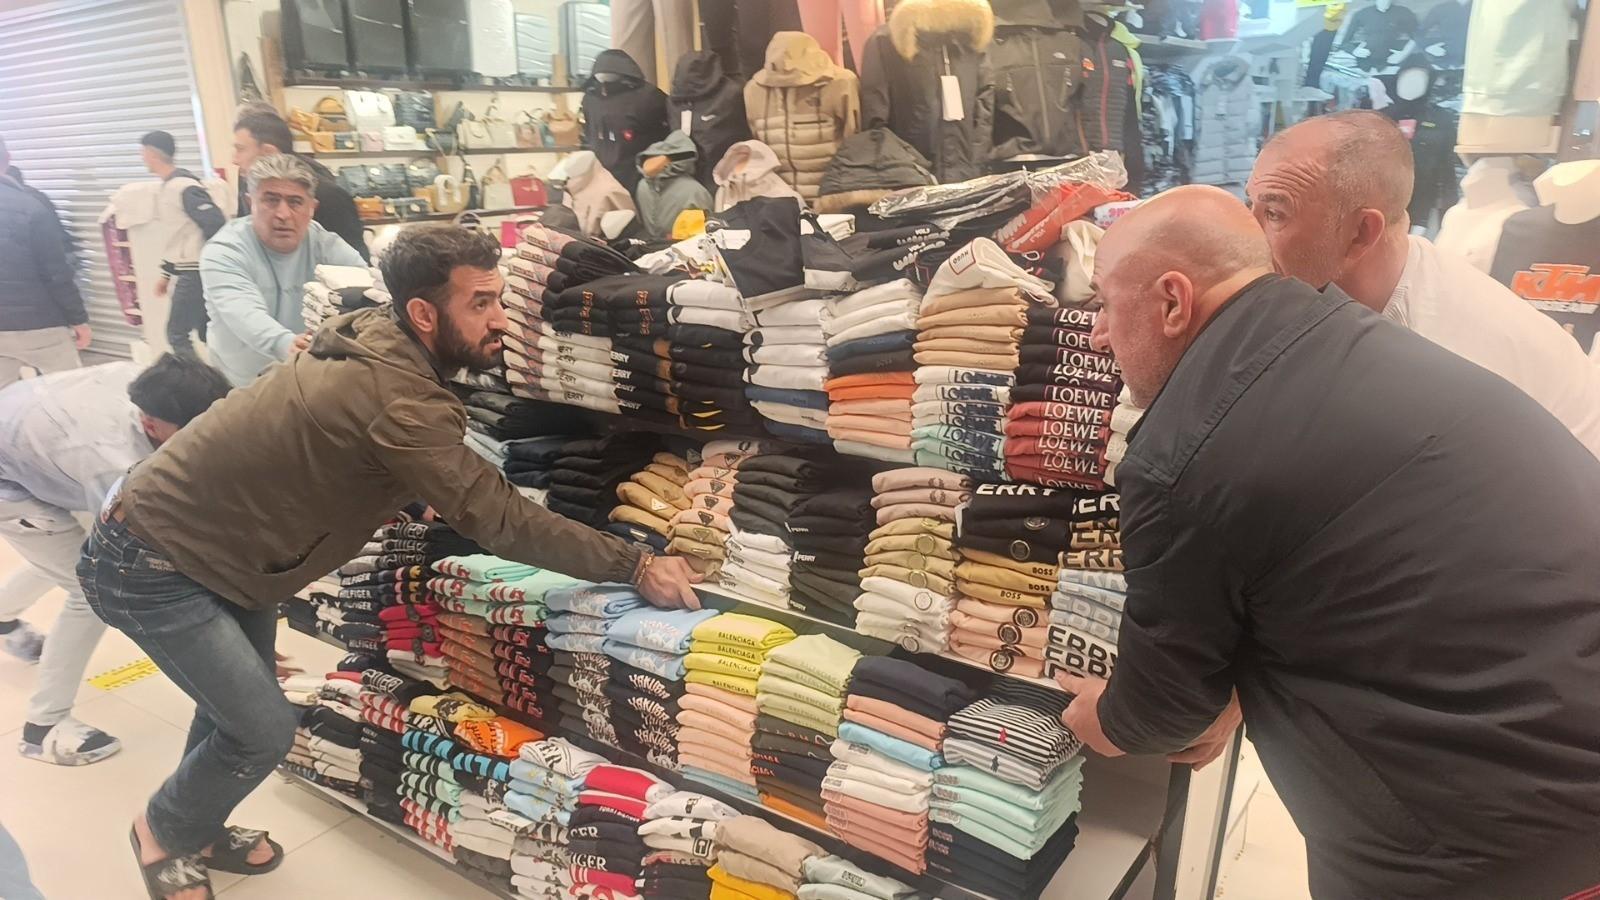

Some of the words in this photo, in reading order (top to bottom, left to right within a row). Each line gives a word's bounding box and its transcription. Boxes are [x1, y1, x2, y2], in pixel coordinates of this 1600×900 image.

[952, 250, 969, 265] HUGO
[1062, 350, 1121, 375] LOEWE
[1053, 363, 1113, 383] LOEWE
[1052, 386, 1112, 408] LOEWE
[1044, 401, 1104, 425] LOEWE
[1043, 420, 1100, 440] LOEWE
[1038, 436, 1095, 454] LOEWE
[1043, 453, 1099, 475] LOEWE
[1032, 567, 1053, 576] BOSS
[1000, 590, 1022, 600] BOSS
[1028, 583, 1050, 592] BOSS
[718, 631, 755, 647] BALENCIAGA
[717, 645, 755, 660] BALENCIAGA
[718, 658, 757, 673] BALENCIAGA
[712, 680, 750, 694] BALENCIAGA
